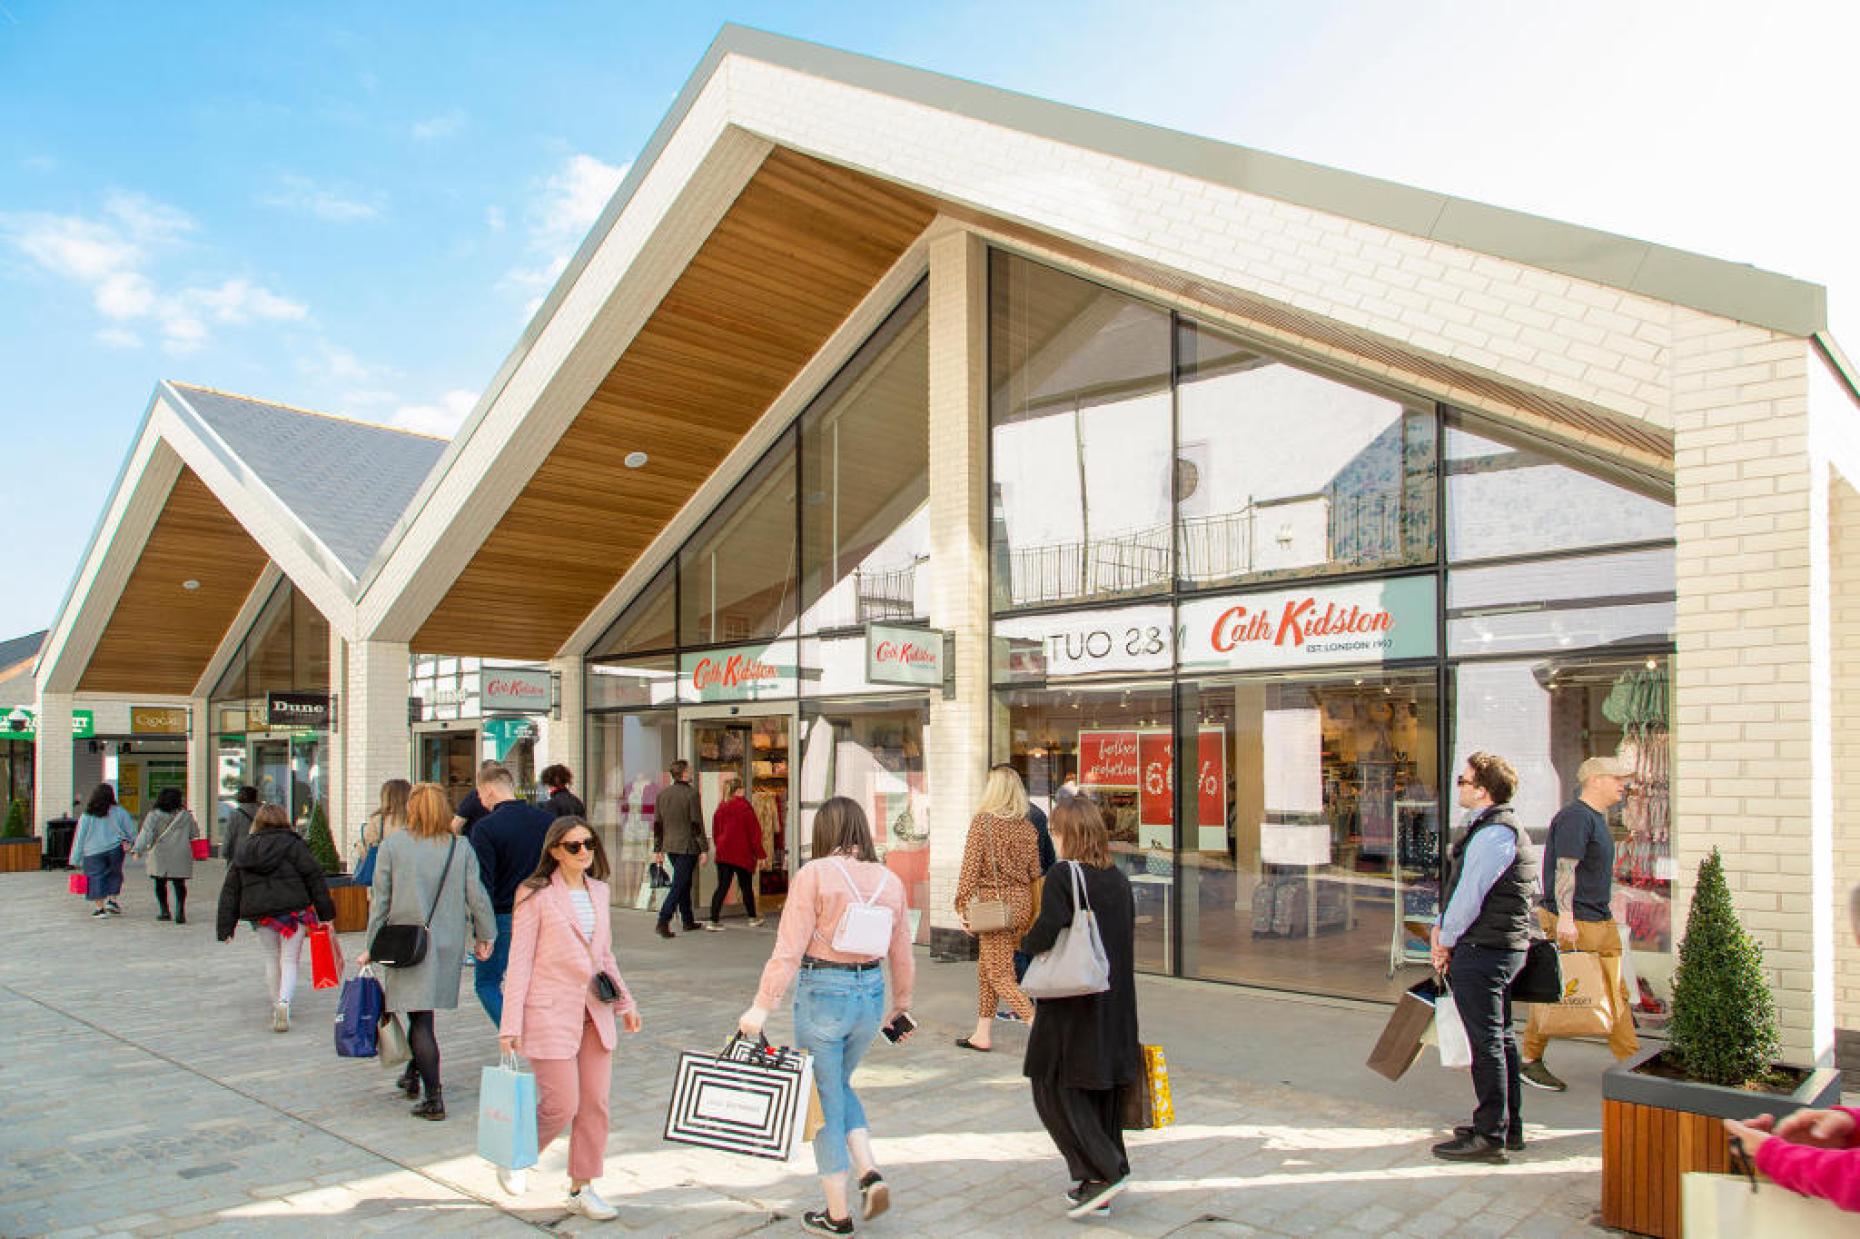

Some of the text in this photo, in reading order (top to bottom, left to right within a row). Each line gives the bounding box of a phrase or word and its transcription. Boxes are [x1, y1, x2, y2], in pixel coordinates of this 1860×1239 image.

[1211, 597, 1394, 652] Cath Kidston
[876, 640, 936, 664] Cath Kidston
[1325, 642, 1369, 651] LONDON
[693, 654, 778, 690] Cath Kidston
[488, 679, 545, 697] Cath Kidston
[273, 699, 325, 714] Dune
